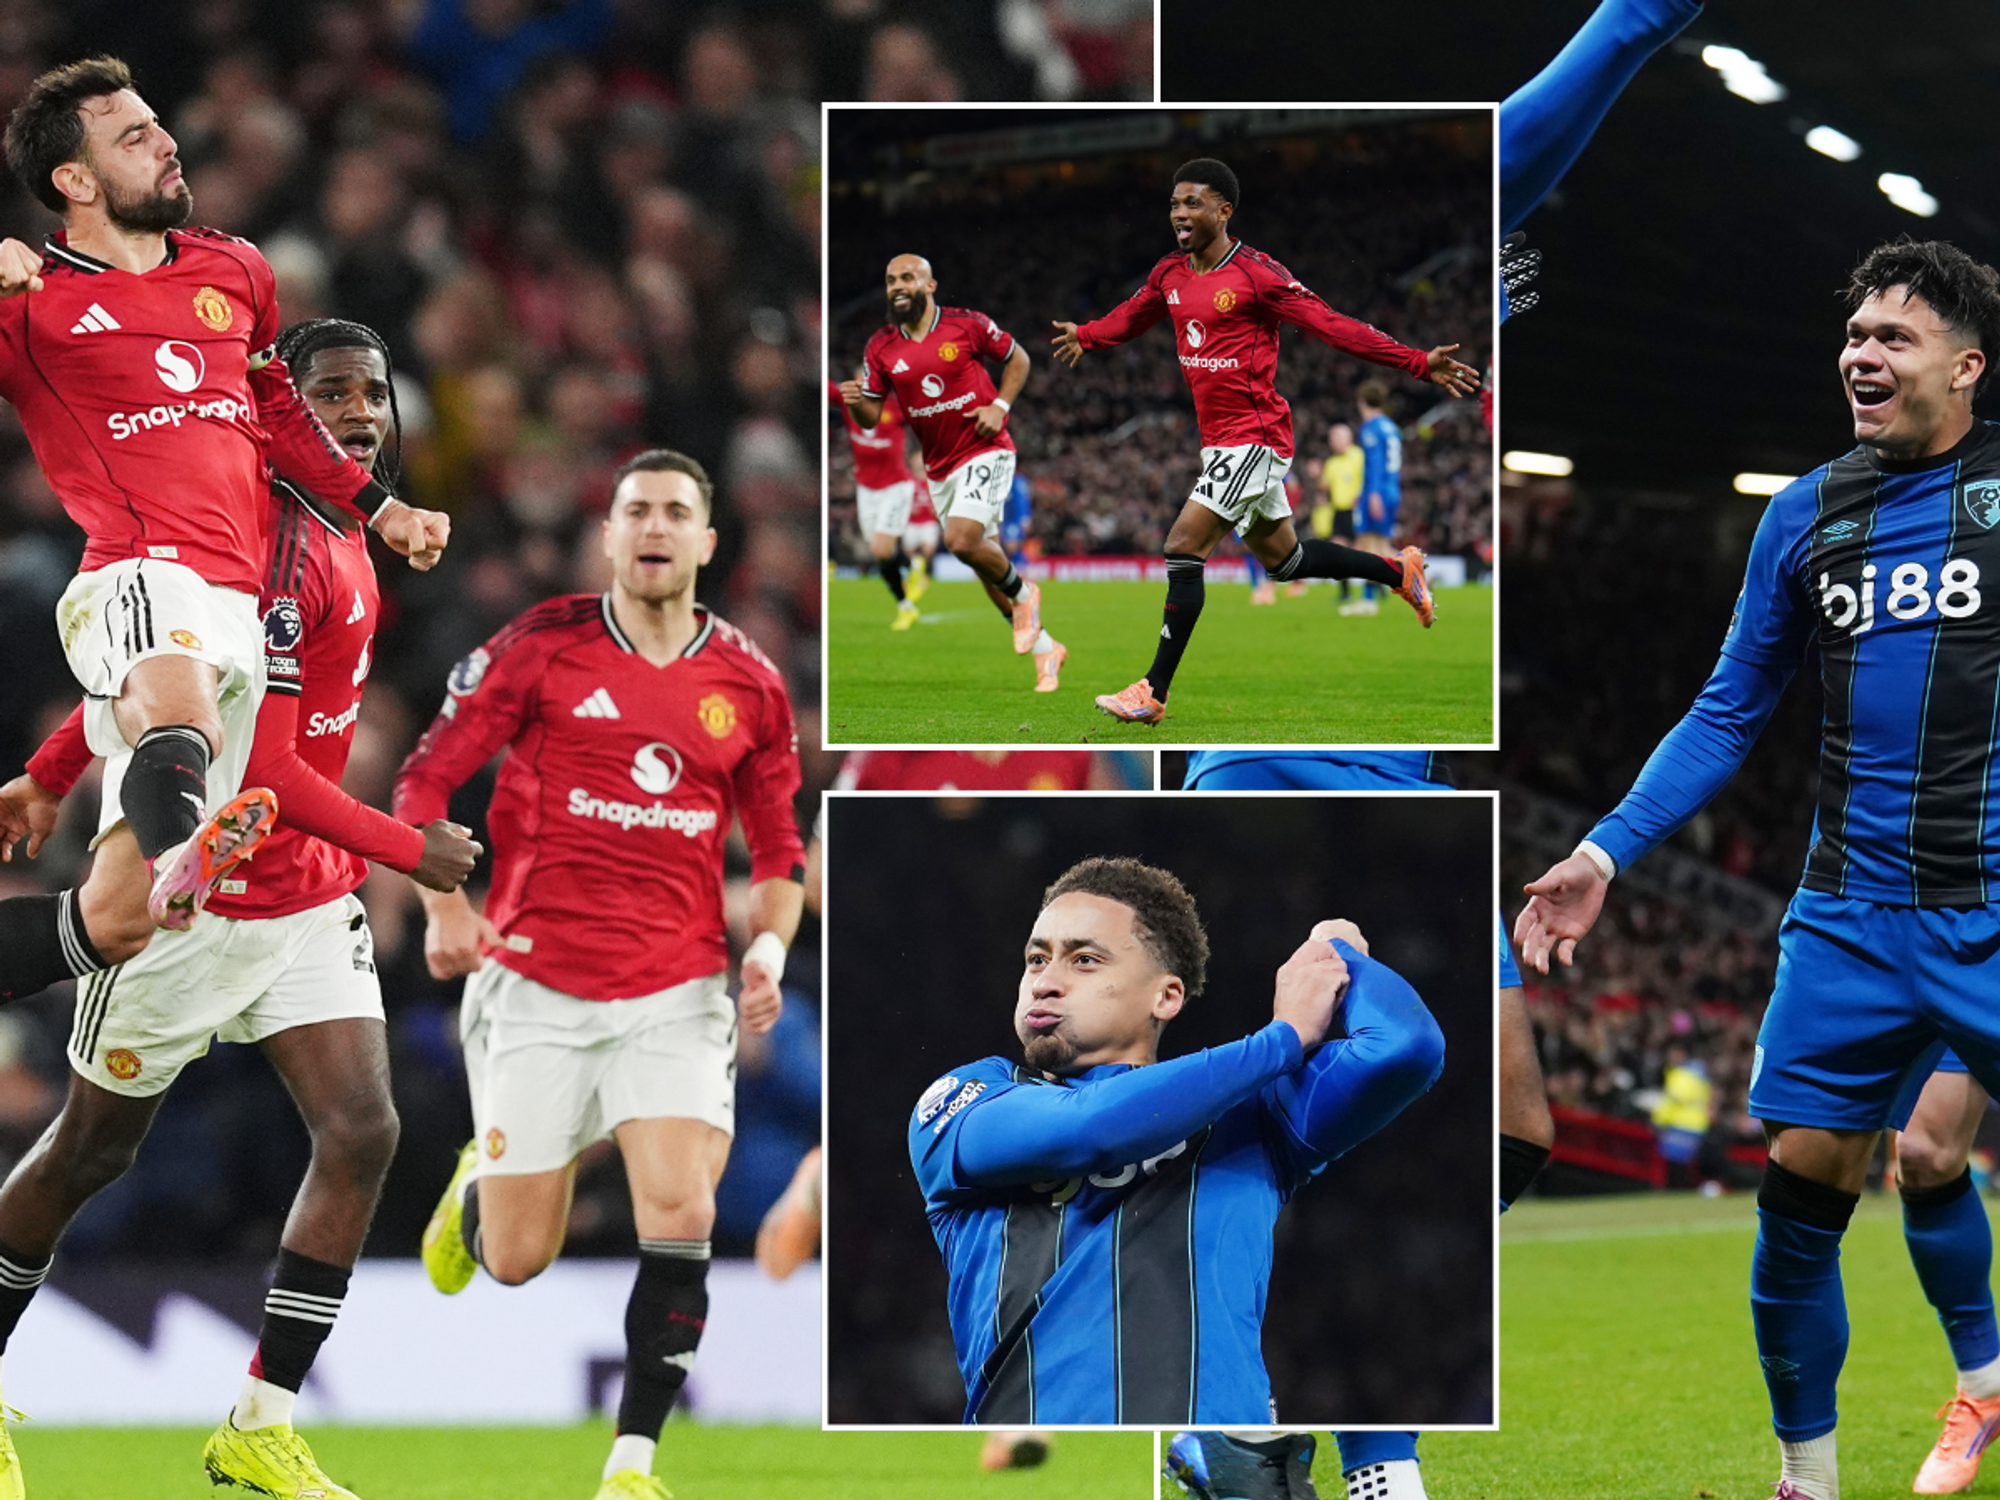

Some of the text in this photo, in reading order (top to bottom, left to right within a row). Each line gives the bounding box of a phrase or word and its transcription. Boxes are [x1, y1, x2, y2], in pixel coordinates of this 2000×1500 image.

[965, 464, 991, 488] 19
[1202, 449, 1236, 483] 16
[1818, 558, 1982, 636] bj88
[567, 787, 718, 838] Snapdragon
